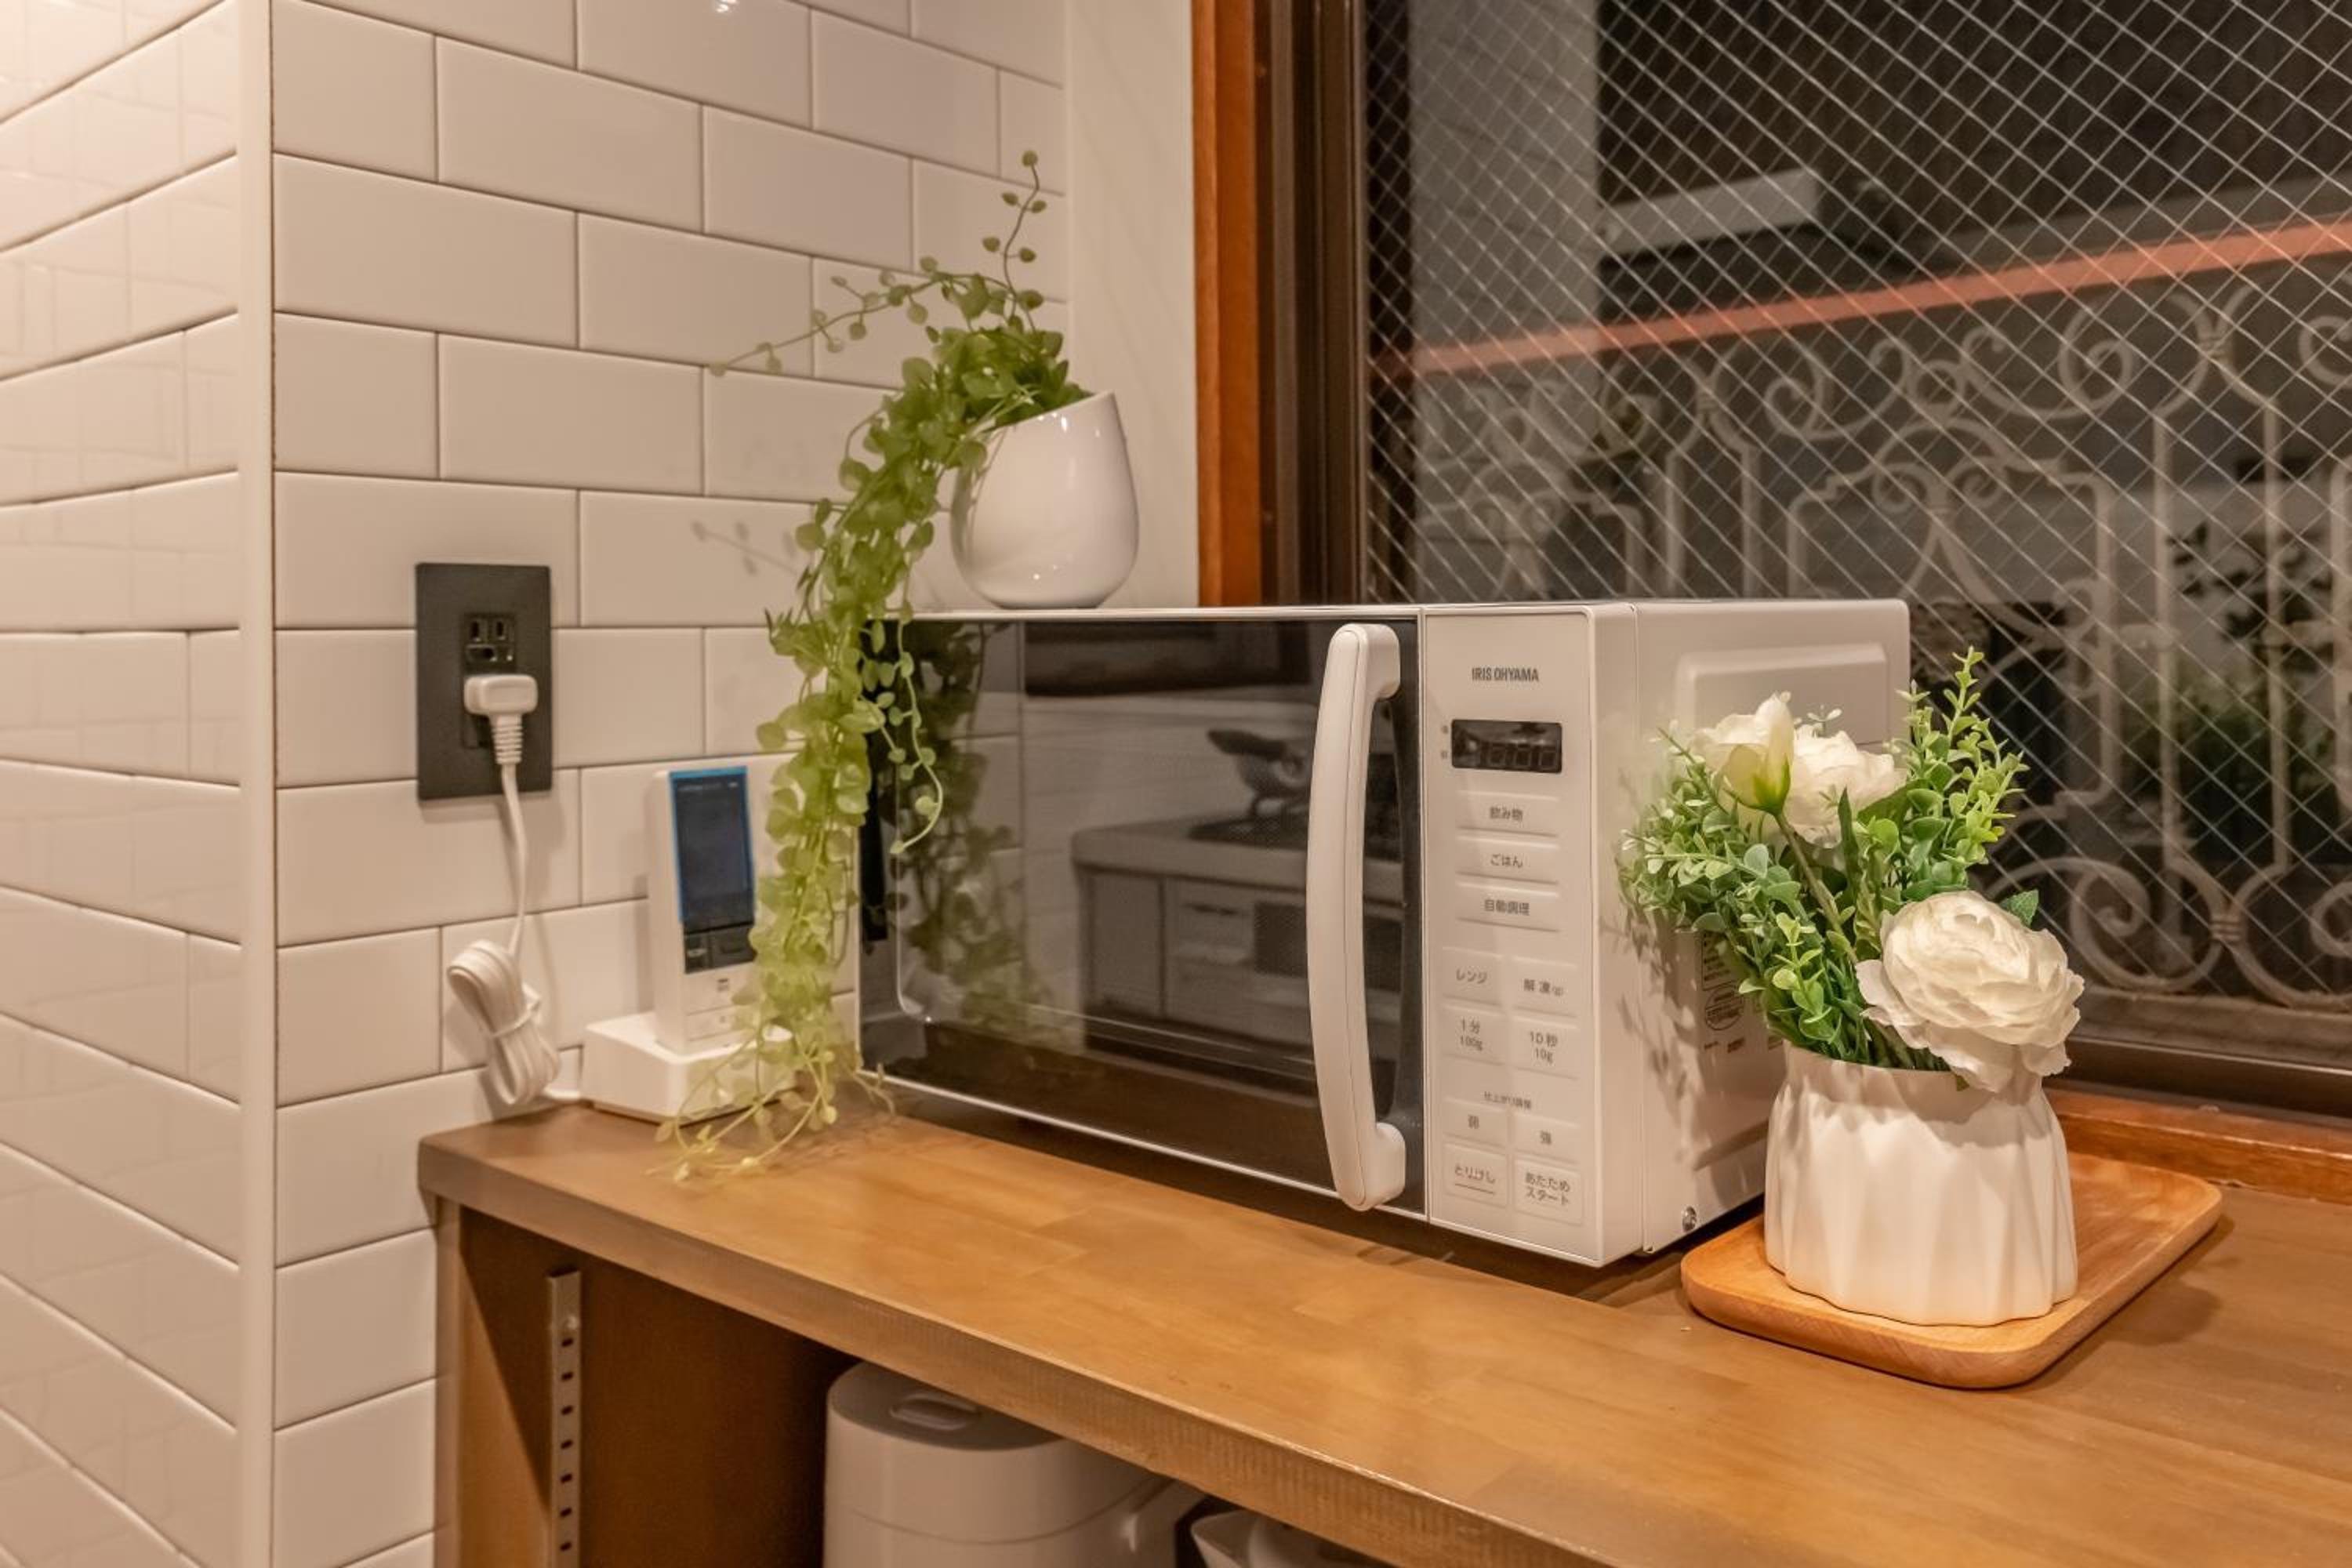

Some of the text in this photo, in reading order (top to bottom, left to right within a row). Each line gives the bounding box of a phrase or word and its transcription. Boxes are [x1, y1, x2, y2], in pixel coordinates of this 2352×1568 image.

[1472, 667, 1539, 682] IRIS OHYAMA
[1490, 854, 1523, 868] ごはん
[1484, 899, 1530, 916] 自動調理
[1454, 1165, 1495, 1184] とりけし
[1525, 1172, 1570, 1192] あたため
[1526, 1185, 1569, 1205] スタート
